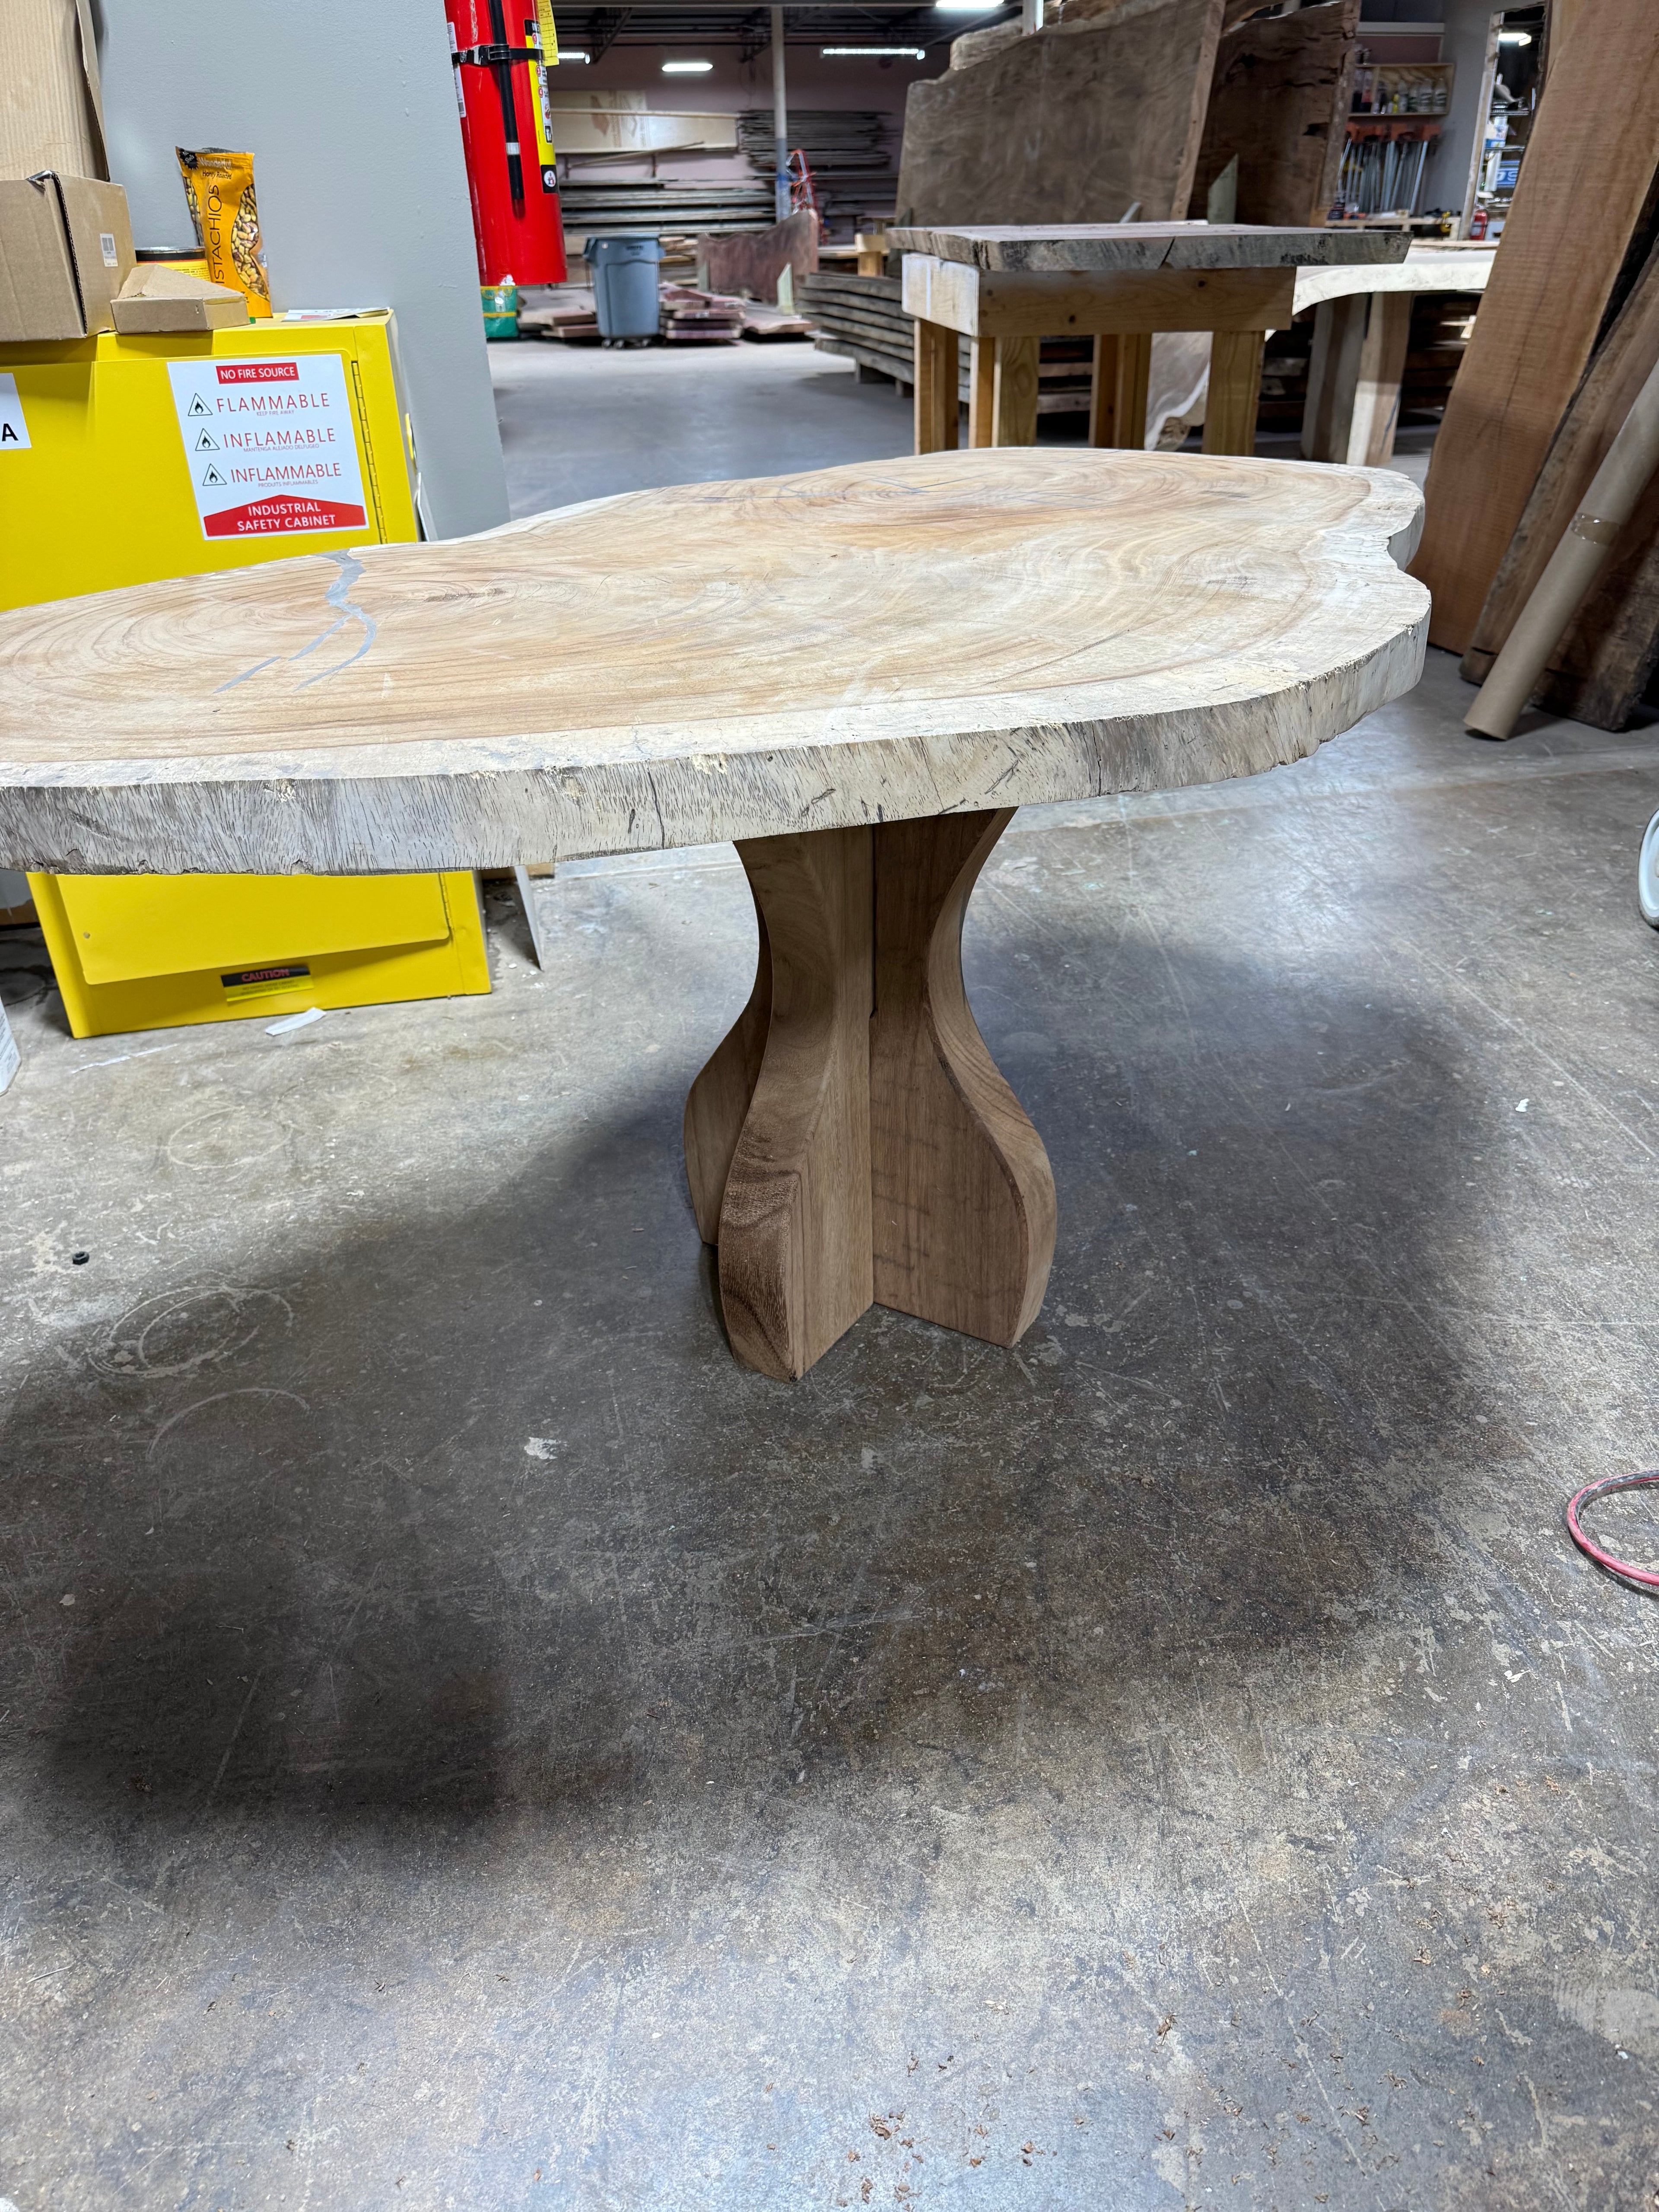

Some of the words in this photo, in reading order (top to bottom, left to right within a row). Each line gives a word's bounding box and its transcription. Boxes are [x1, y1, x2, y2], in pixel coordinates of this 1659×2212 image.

[208, 185, 225, 283] ISTACHIOS
[220, 370, 235, 380] NO
[238, 369, 257, 379] FIRE
[258, 366, 296, 378] SOURCE
[216, 393, 330, 413] FLAMMABLE
[2, 423, 19, 442] A
[223, 428, 336, 448] INFLAMABLE
[231, 463, 342, 483] INFLAMMABLE
[248, 502, 321, 517] INDUSTRIAL
[237, 518, 281, 531] SAFETY
[284, 514, 336, 528] CABINET
[242, 969, 290, 982] CAUTION
